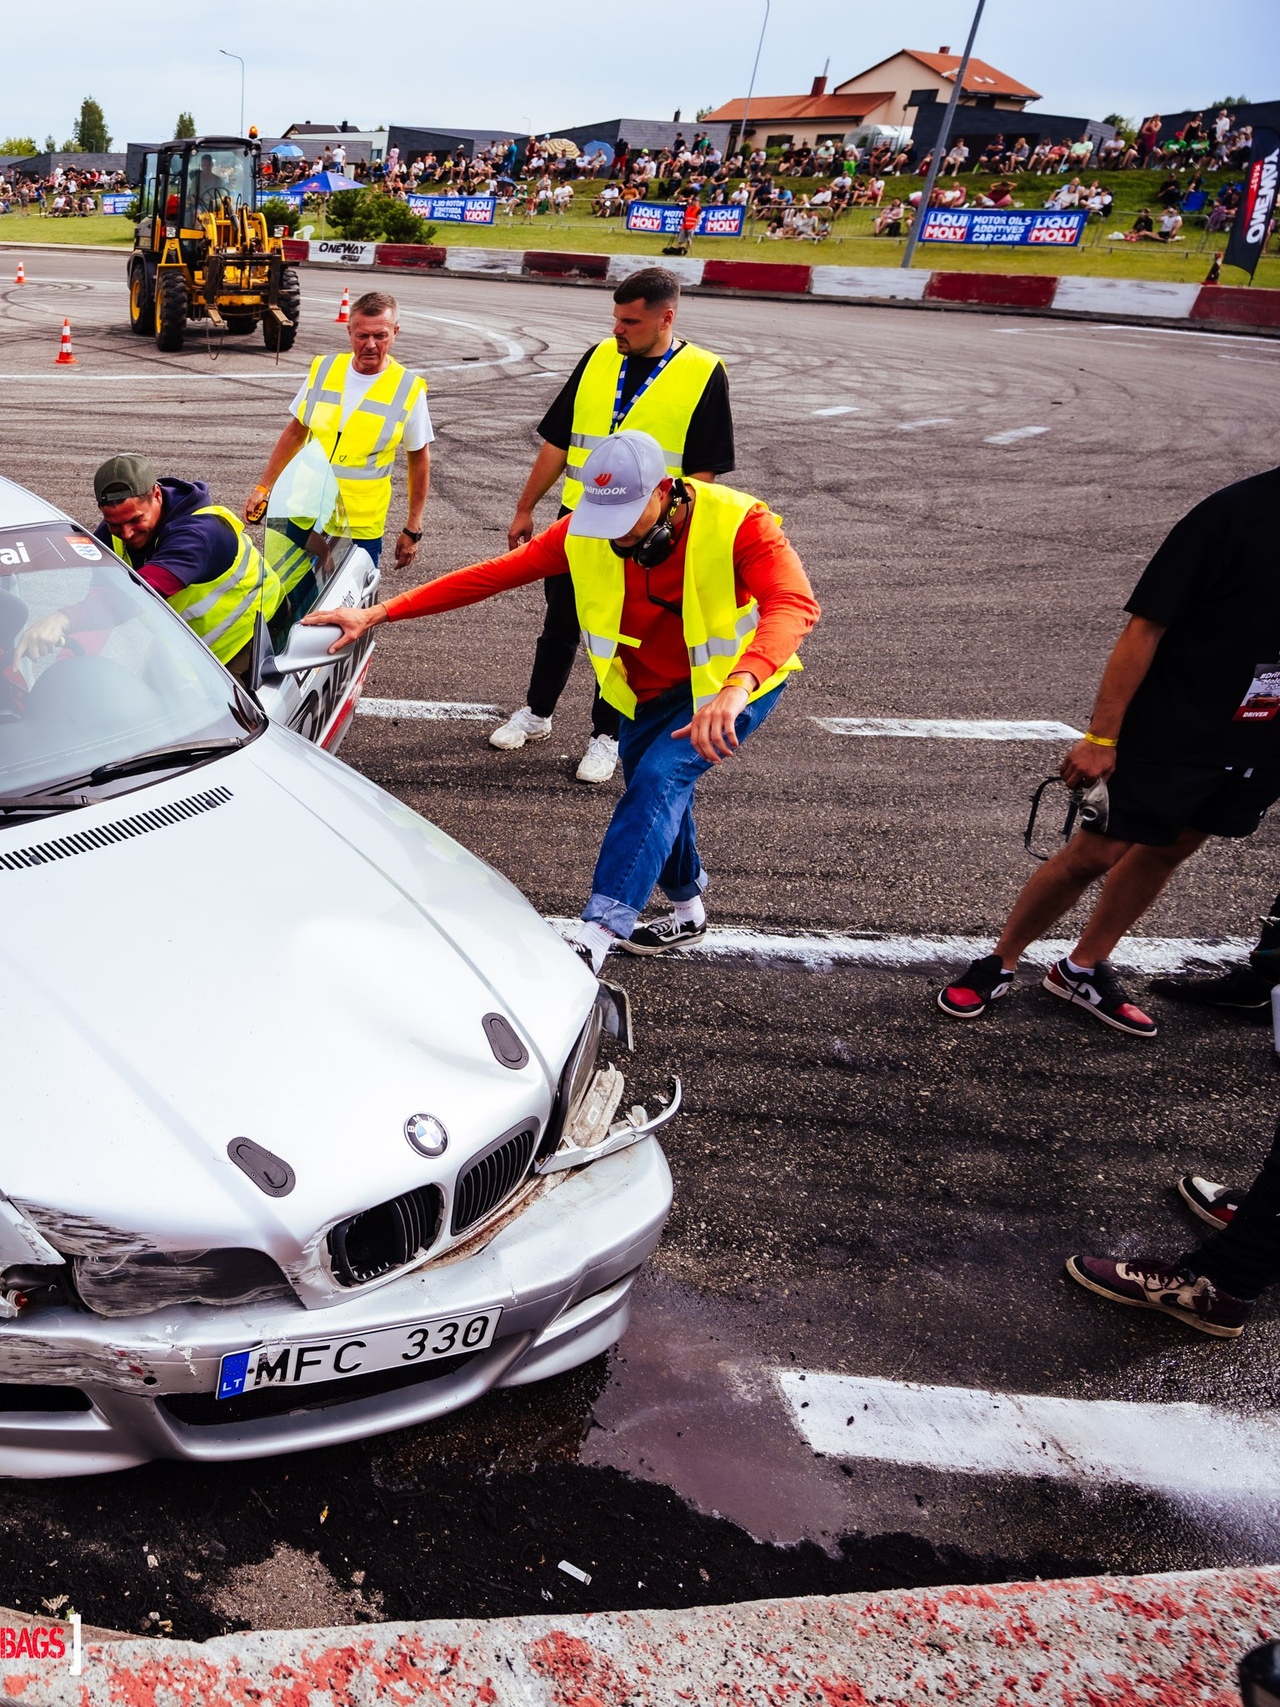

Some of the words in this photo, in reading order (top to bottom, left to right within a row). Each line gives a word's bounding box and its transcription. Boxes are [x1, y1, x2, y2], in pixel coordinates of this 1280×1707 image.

[633, 206, 661, 219] LIQUI
[709, 209, 739, 220] LIQUI
[630, 217, 661, 229] MOLY
[706, 220, 739, 232] MOLY
[929, 213, 969, 226] LIQUI
[972, 216, 1007, 225] MOTOR
[1008, 216, 1032, 225] OILS
[1034, 215, 1080, 229] LIQUI
[925, 225, 966, 239] MOLY
[972, 225, 1025, 233] ADDITIVES
[1030, 228, 1077, 242] MOLY
[972, 233, 993, 241] CAR
[407, 1115, 436, 1133] BMW
[254, 1340, 367, 1386] MFC
[401, 1315, 490, 1361] 330
[222, 1377, 243, 1391] LT
